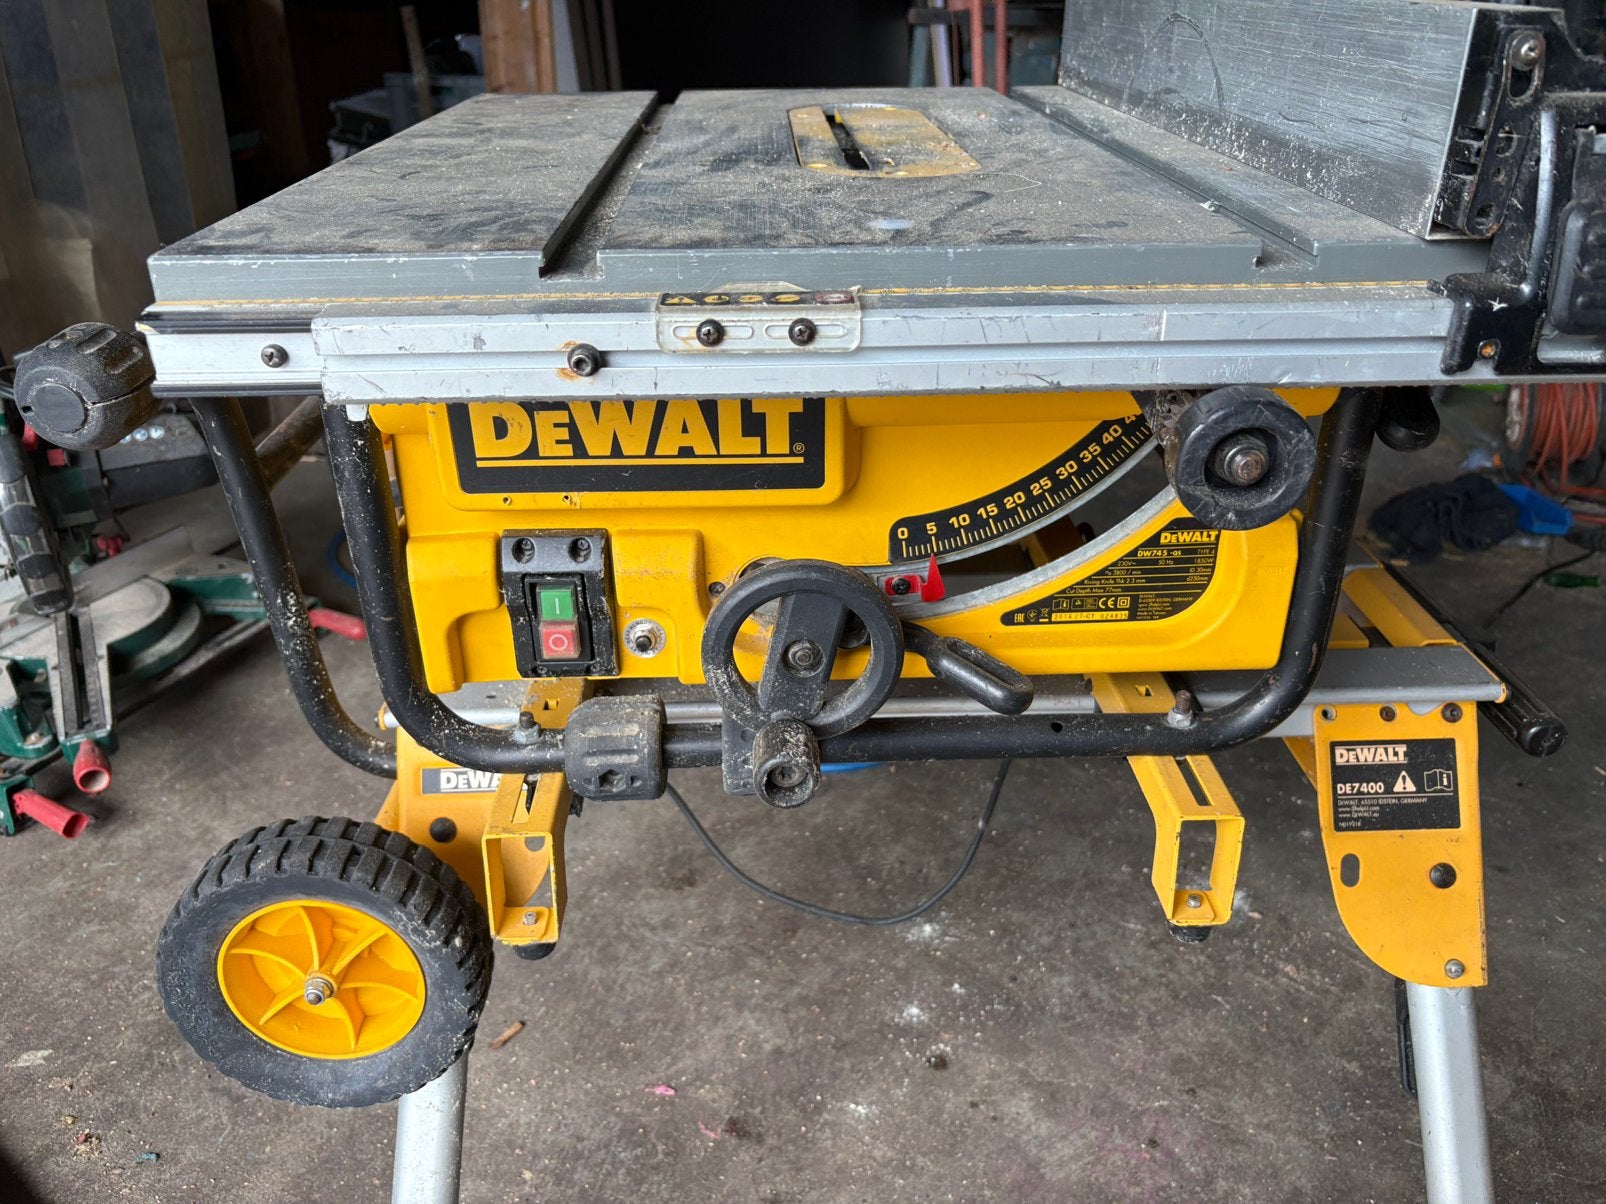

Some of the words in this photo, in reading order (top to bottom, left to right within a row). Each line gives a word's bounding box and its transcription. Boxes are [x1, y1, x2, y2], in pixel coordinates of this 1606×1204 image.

[897, 527, 909, 540] 0
[926, 522, 937, 534] 5
[949, 513, 970, 529] 10
[977, 503, 998, 520] 15
[1003, 490, 1026, 510] 20
[1030, 476, 1052, 496] 25
[1055, 460, 1079, 480] 30
[1079, 442, 1102, 463] 35
[1102, 424, 1123, 445] 40
[1337, 782, 1385, 794] DE7400
